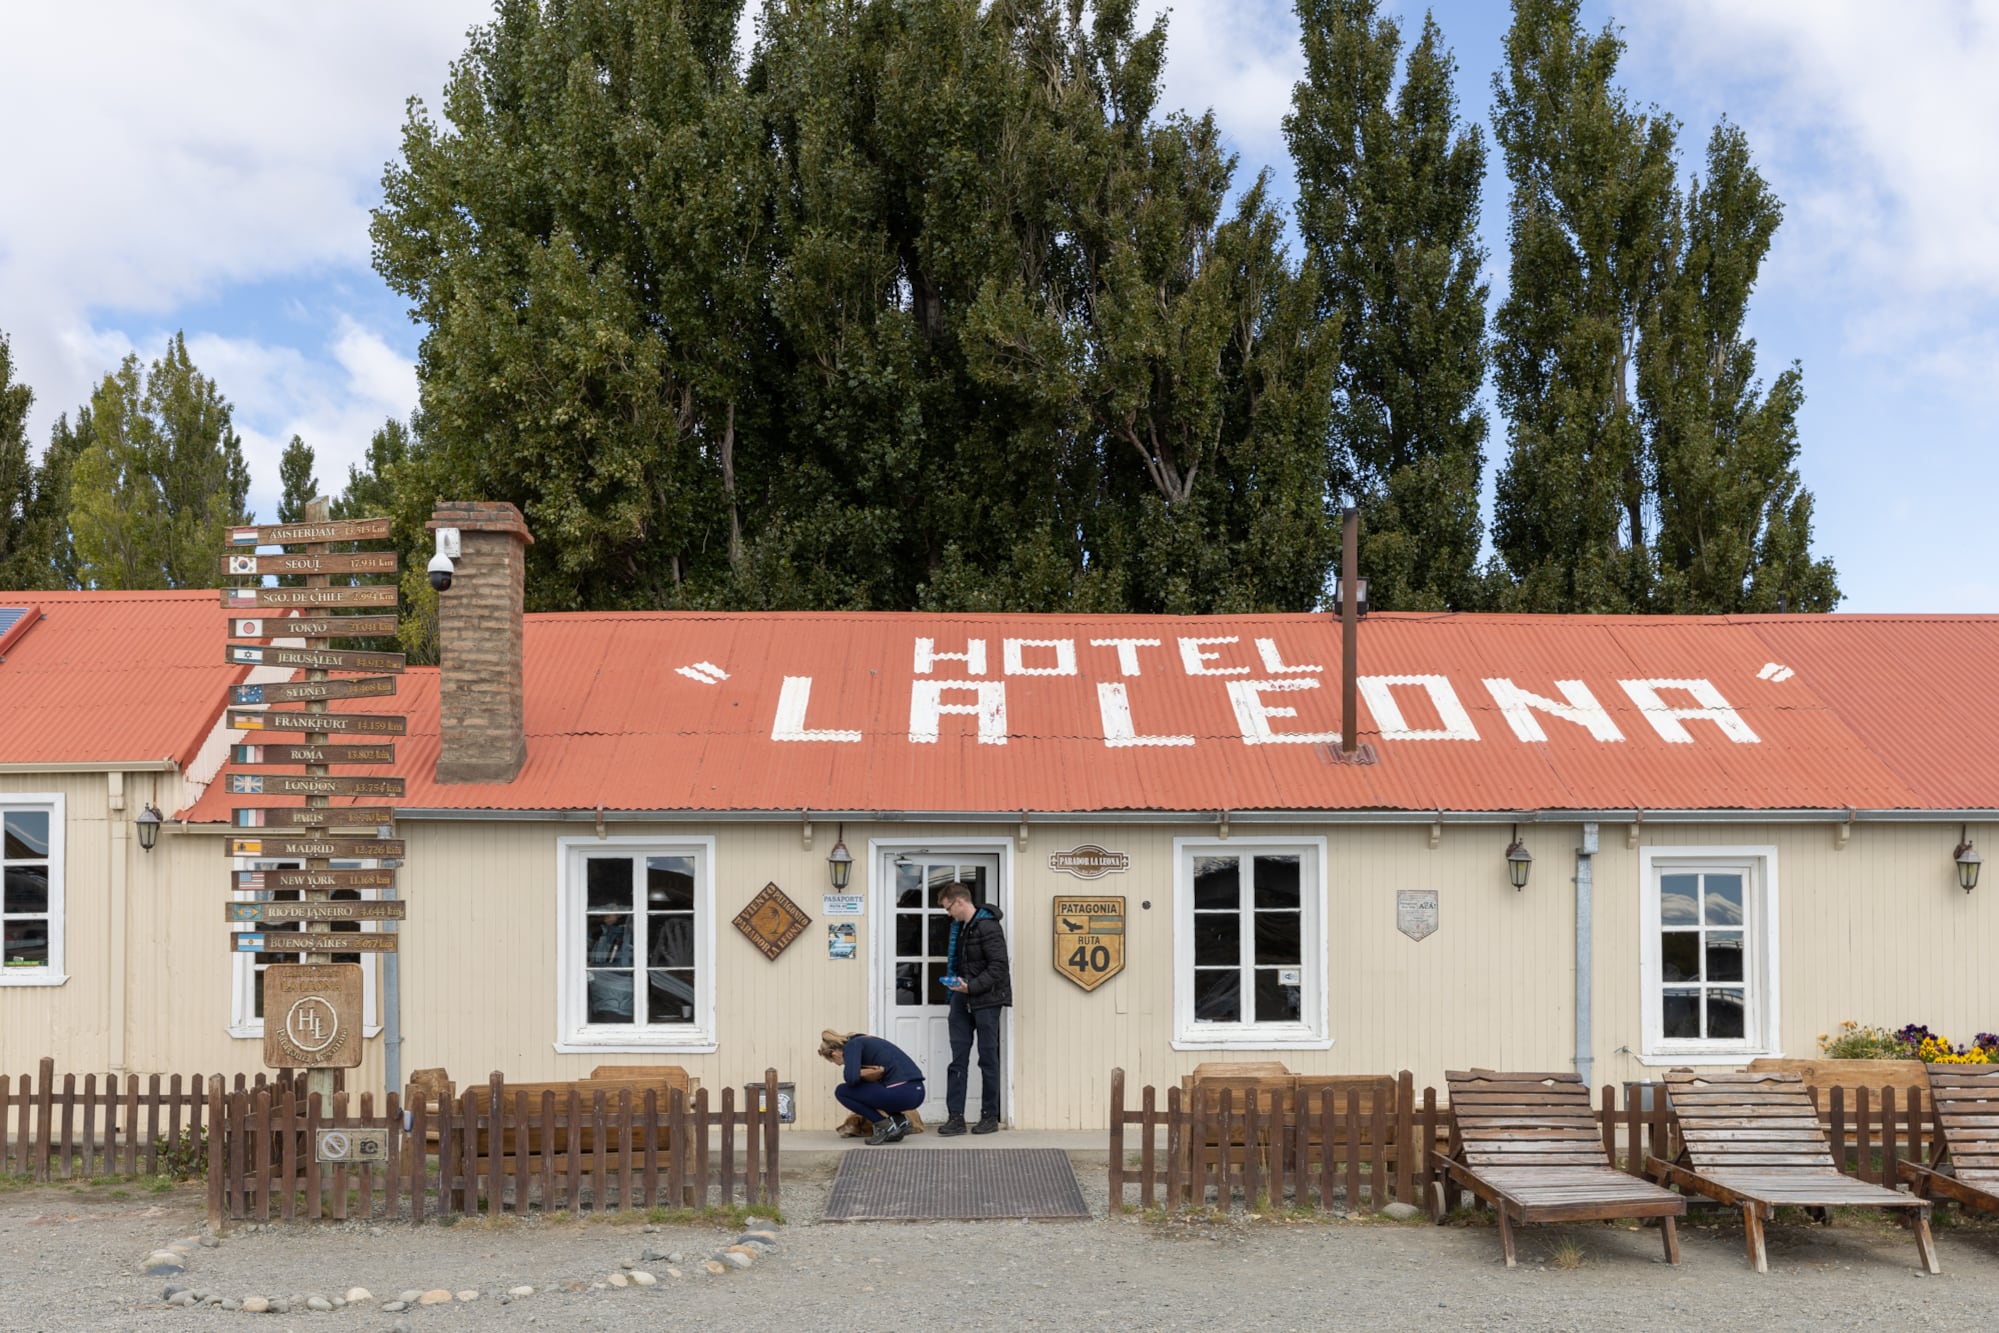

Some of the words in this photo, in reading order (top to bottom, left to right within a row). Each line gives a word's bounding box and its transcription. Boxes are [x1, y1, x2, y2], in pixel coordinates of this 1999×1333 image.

[269, 527, 336, 541] AMSTERDAM
[371, 524, 387, 534] km
[285, 559, 323, 569] SEOUL
[378, 558, 394, 567] km
[263, 594, 289, 602] SGO.
[292, 593, 307, 602] DE
[309, 592, 344, 602] CHILE
[379, 591, 394, 600] km
[288, 623, 328, 633] TOKYO
[378, 622, 394, 631] km
[278, 652, 343, 666] JERUSALEM
[914, 636, 1323, 676] HOTEL
[286, 686, 328, 698] SYDNEY
[377, 681, 392, 691] km
[274, 716, 349, 729] FRANKFURT
[387, 721, 403, 731] km
[290, 750, 324, 760] ROMA
[375, 749, 390, 759] km
[285, 780, 336, 791] LONDON
[386, 782, 402, 793] km
[293, 812, 324, 823] PARIS
[376, 811, 390, 822] km
[286, 843, 335, 854] MADRID
[386, 844, 402, 855] km
[1059, 857, 1089, 866] PARADOR
[1090, 857, 1099, 866] LA
[1099, 857, 1120, 866] LEONA
[280, 876, 307, 885] NEW
[306, 875, 336, 885] YORK
[376, 874, 390, 884] km
[741, 885, 777, 920] VIENTO
[824, 895, 864, 903] PASAPORTE
[268, 907, 288, 917] RIO
[288, 907, 306, 917] DE
[307, 906, 353, 918] JANEIRO
[1061, 903, 1117, 914] PATAGONIA
[270, 937, 315, 949] BUENOS
[315, 936, 348, 948] AIRES
[379, 937, 394, 948] km
[733, 917, 771, 953] PARADOR
[767, 945, 780, 960] LA
[777, 923, 803, 949] LEONA
[1078, 935, 1100, 945] RUTA
[1068, 945, 1110, 973] 40
